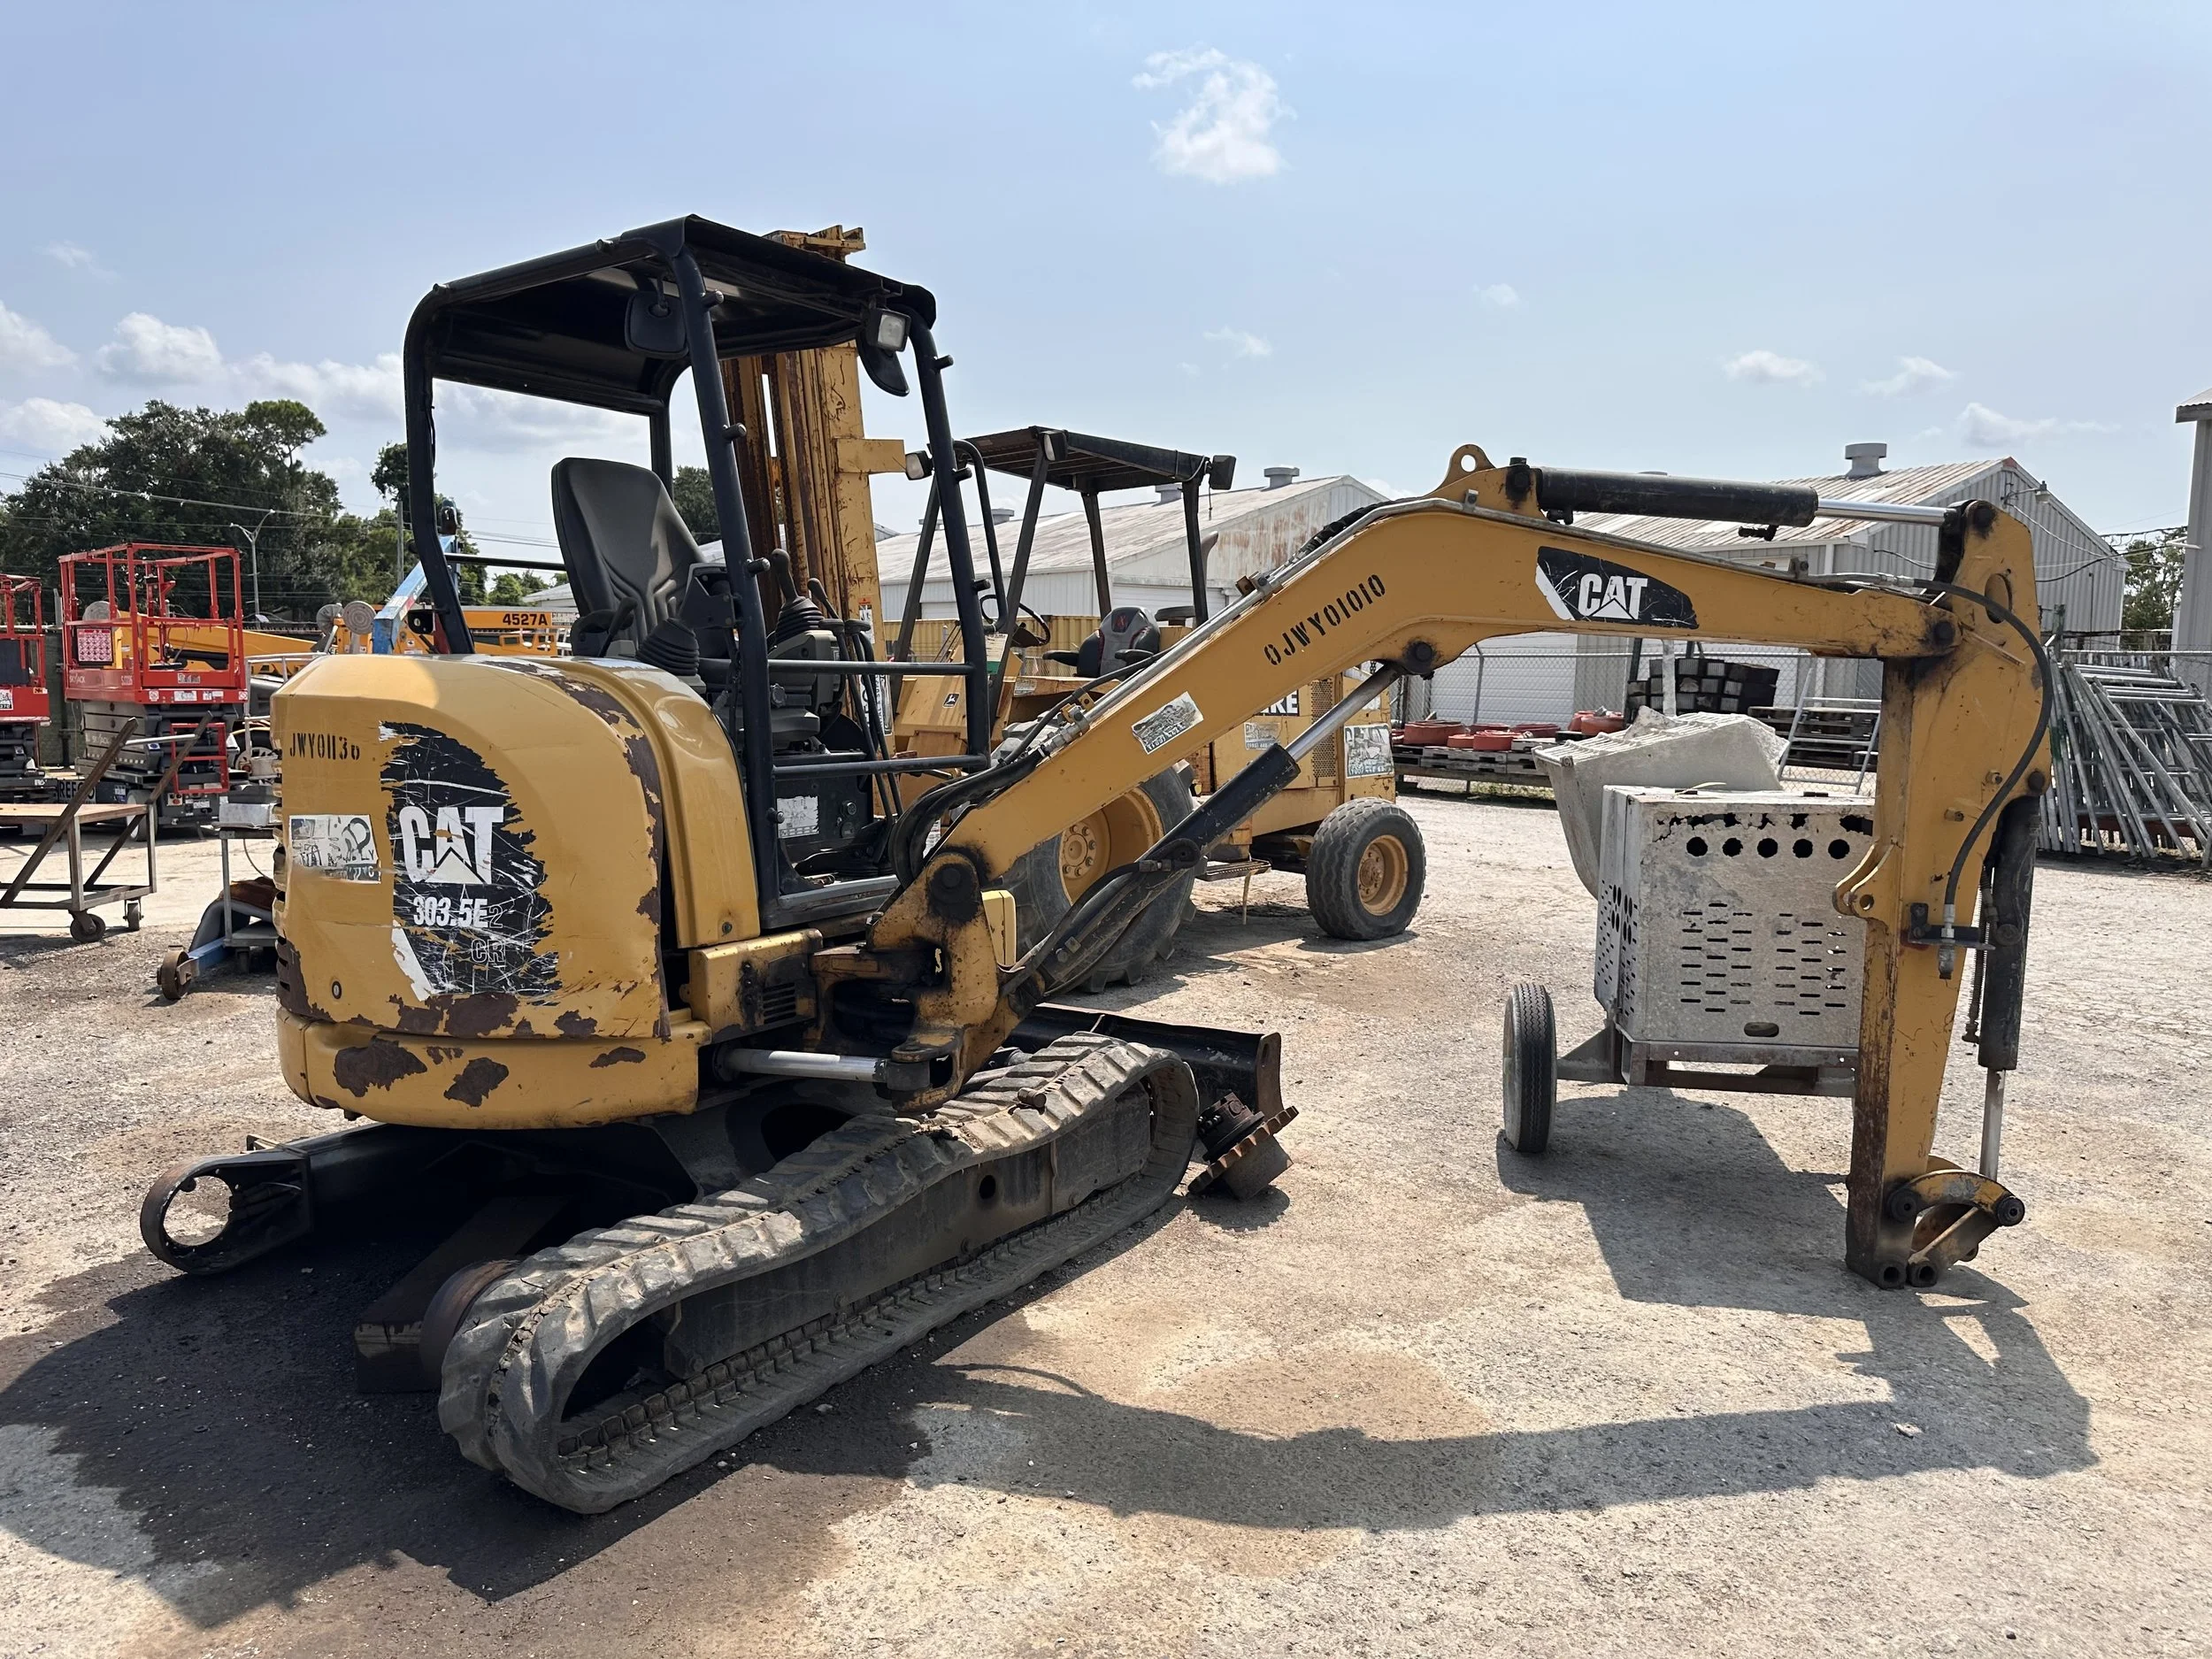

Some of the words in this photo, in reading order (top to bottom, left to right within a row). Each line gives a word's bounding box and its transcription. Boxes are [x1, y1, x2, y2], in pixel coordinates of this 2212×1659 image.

[1578, 573, 1648, 619] CAT
[502, 613, 548, 626] 4527A
[399, 806, 504, 885] CAT
[471, 939, 505, 963] CR
